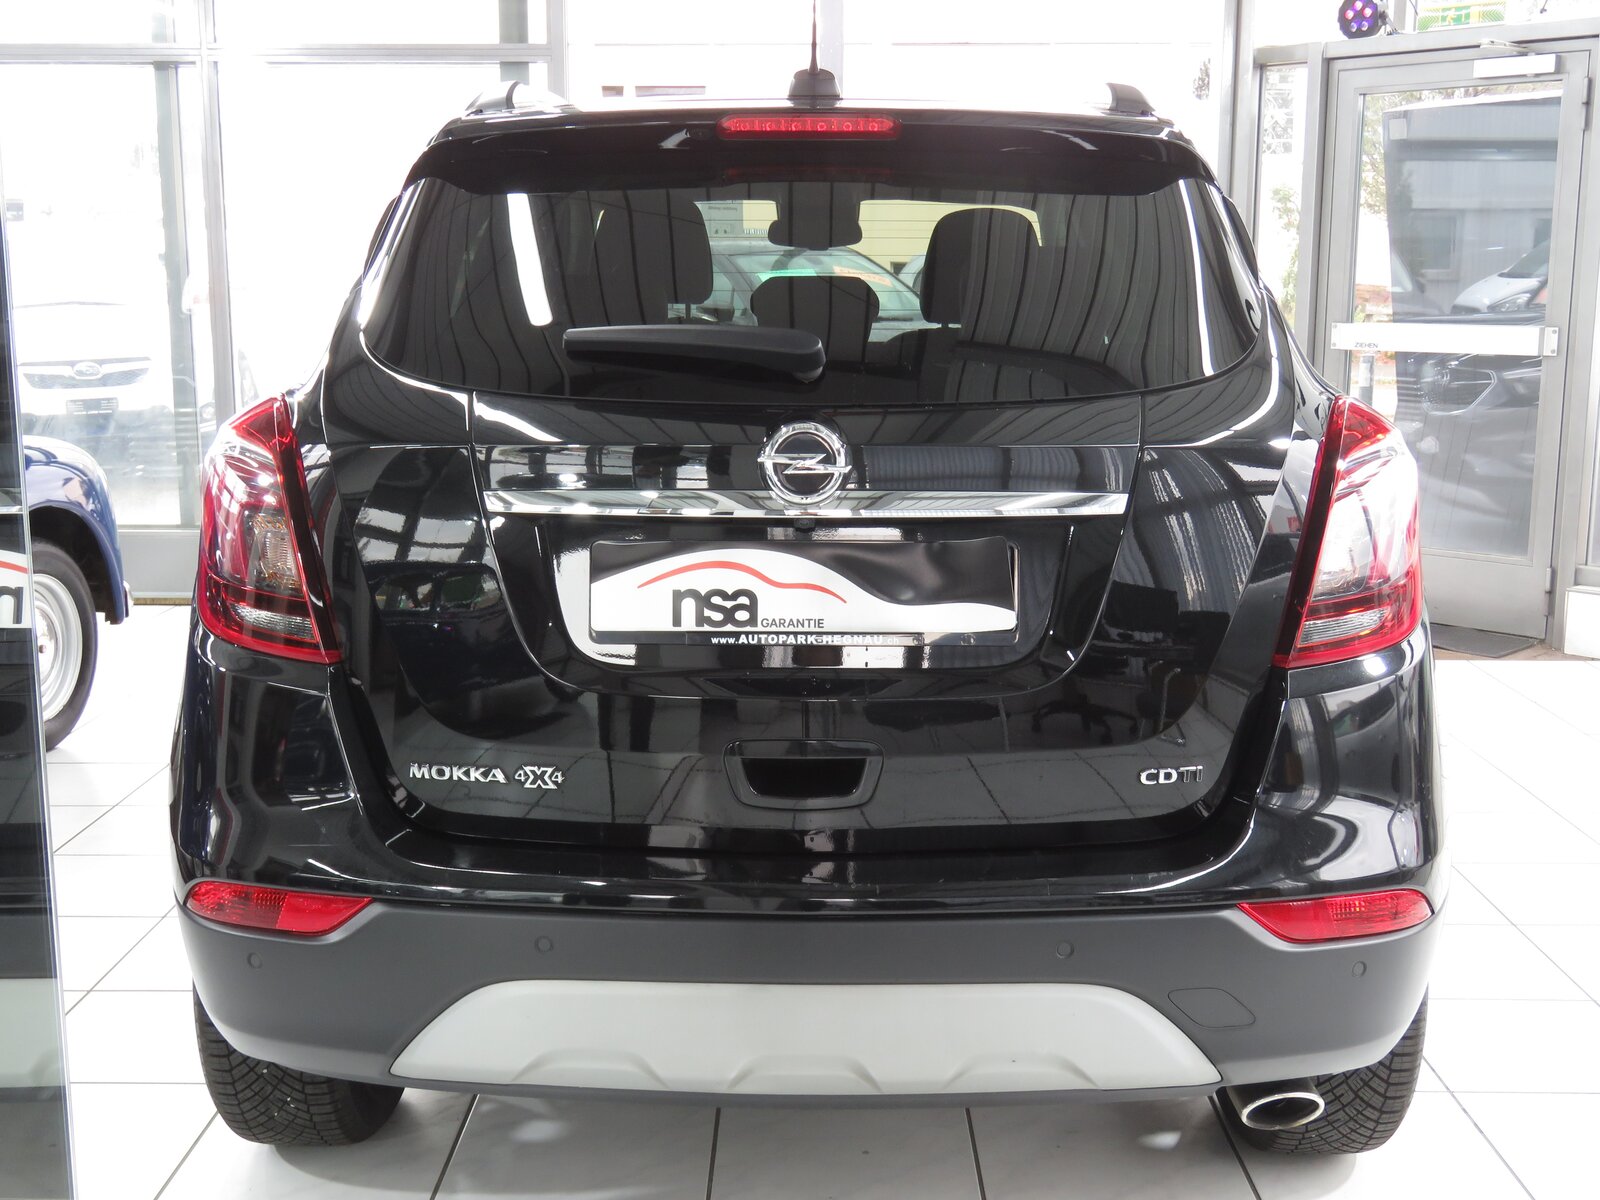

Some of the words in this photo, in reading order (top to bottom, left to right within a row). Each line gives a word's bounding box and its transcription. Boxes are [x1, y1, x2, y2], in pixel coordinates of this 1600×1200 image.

[672, 588, 759, 629] nsa
[760, 617, 825, 629] GARANTIE
[409, 762, 508, 784] MOKKA
[1139, 765, 1204, 785] CDTI
